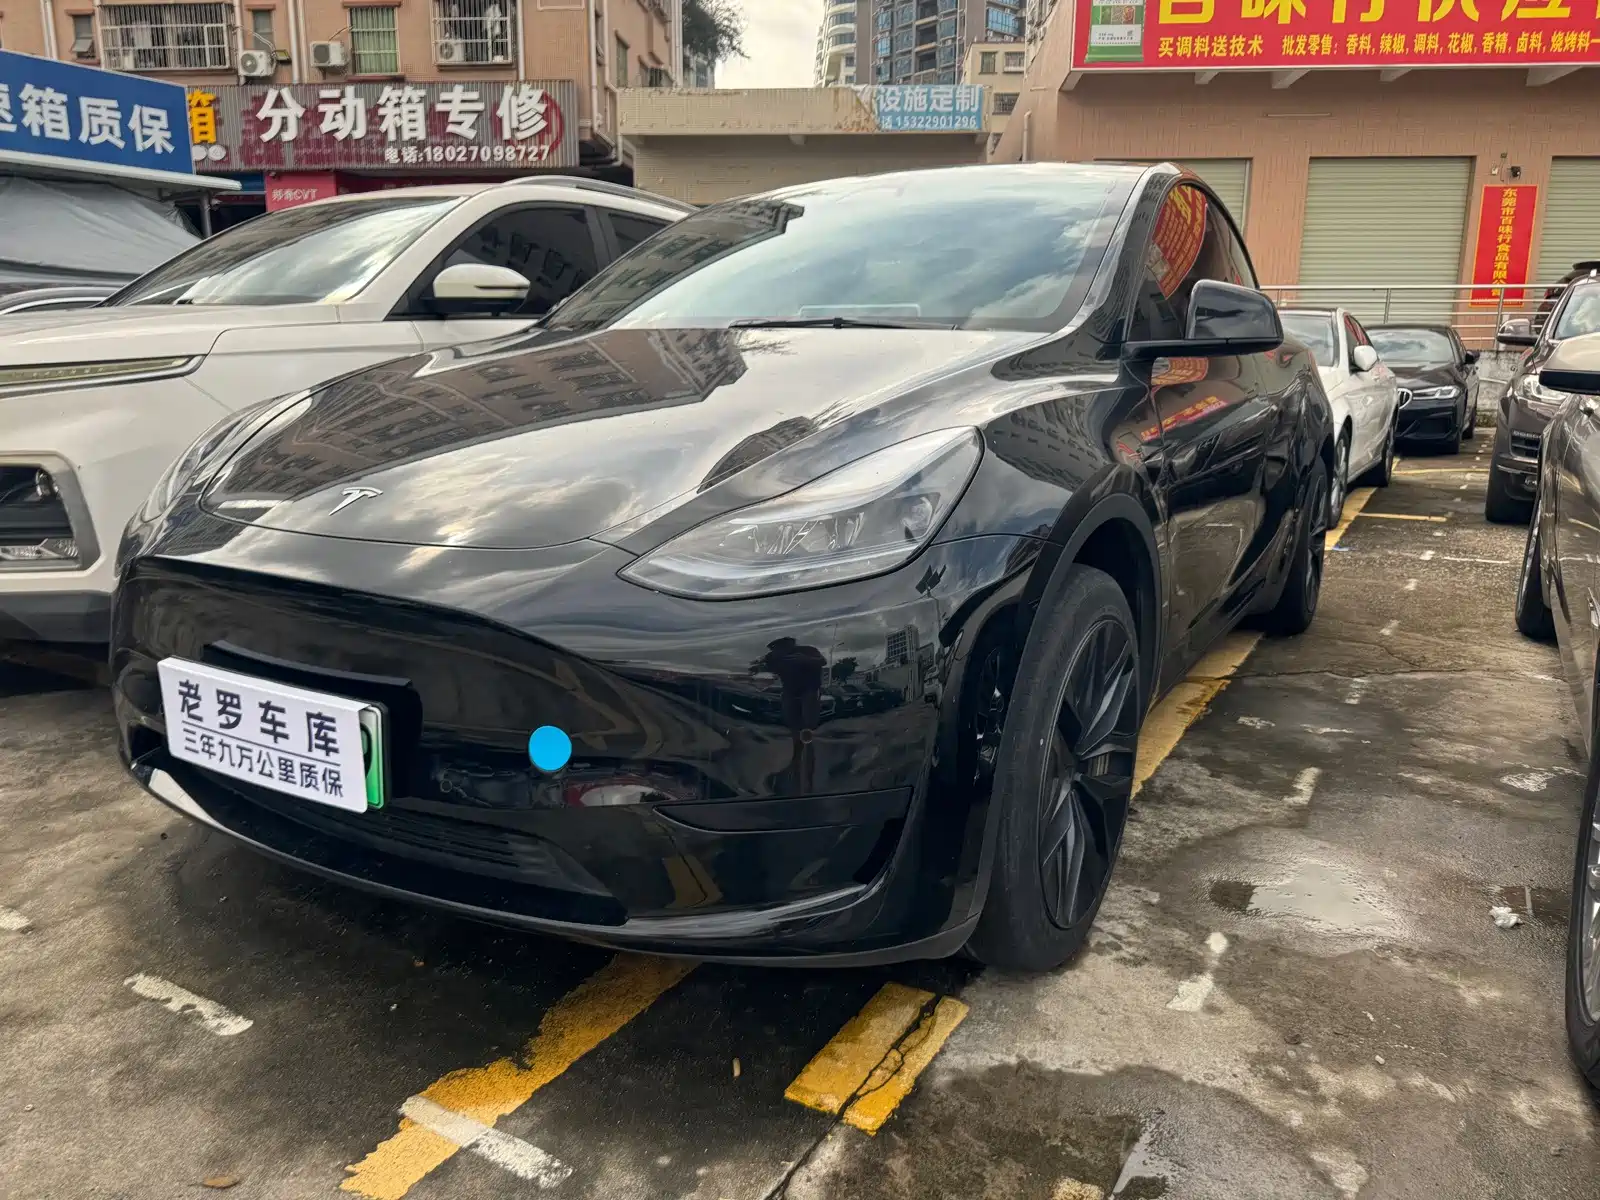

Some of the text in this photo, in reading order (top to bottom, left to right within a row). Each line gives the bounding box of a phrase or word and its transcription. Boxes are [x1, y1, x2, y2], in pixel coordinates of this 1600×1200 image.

[1158, 35, 1264, 58] 买调料送技术
[255, 84, 549, 143] 分动箱专修
[877, 85, 980, 113] 设施定制
[896, 115, 977, 128] 15322901296
[177, 679, 341, 757] 老罗车库
[182, 727, 344, 798] 三年九万公里质保
